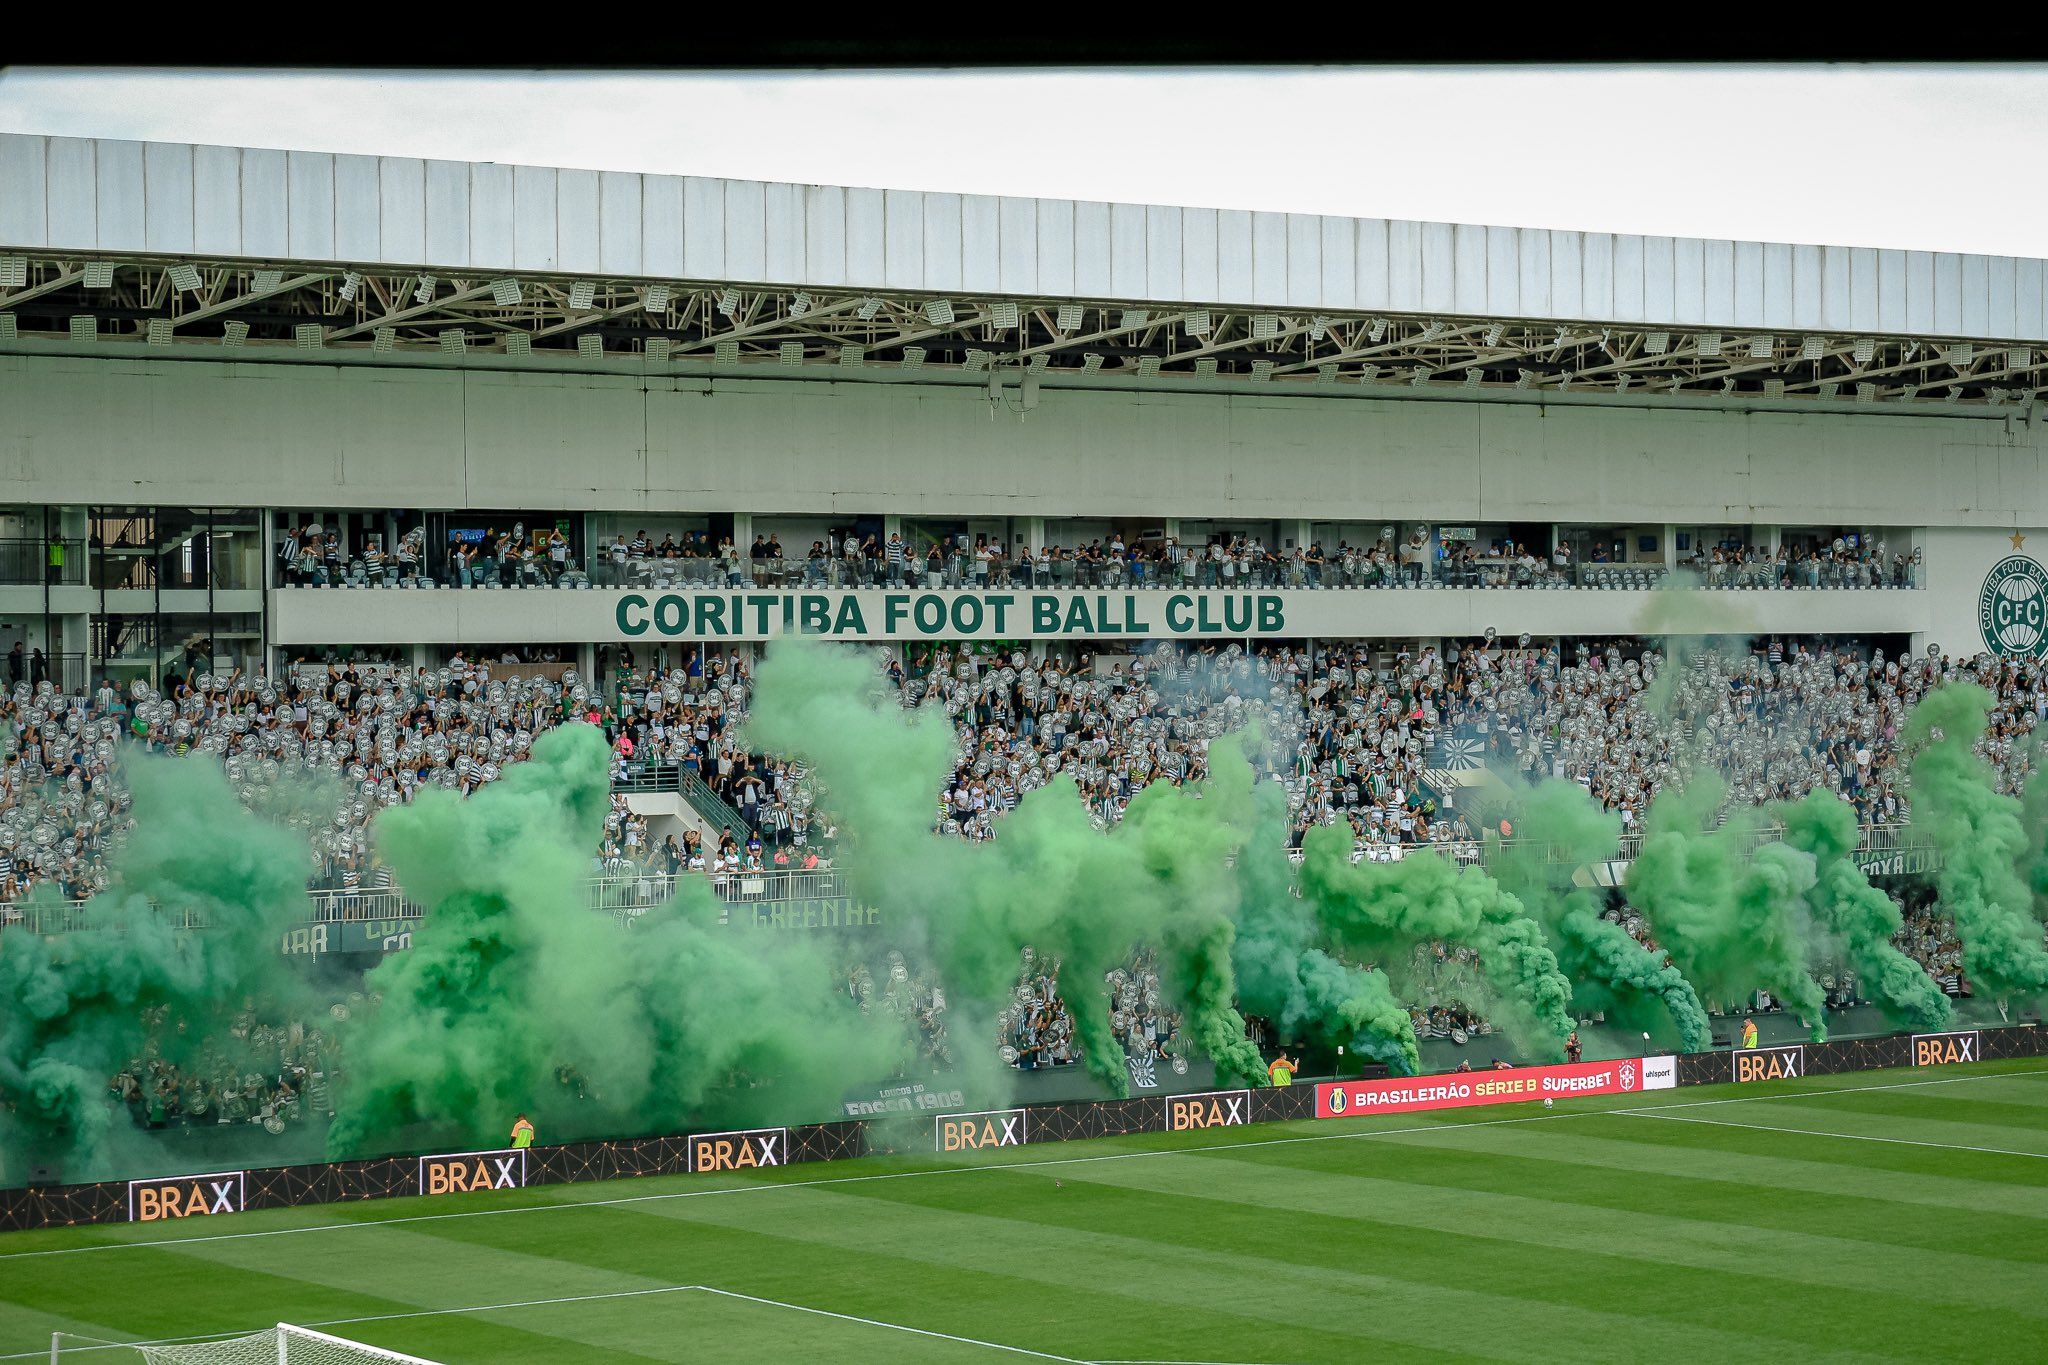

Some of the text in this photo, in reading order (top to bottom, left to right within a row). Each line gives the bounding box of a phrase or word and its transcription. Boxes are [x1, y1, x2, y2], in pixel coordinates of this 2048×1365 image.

[1982, 560, 2048, 630] CORITIBA FOOT BALL
[615, 594, 1286, 635] CORITIBA FOOT BALL CLUB
[1998, 600, 2039, 625] CFC
[752, 899, 839, 928] GREEN
[1739, 1052, 1797, 1082] BRAX
[1918, 1037, 1974, 1066] BRAX
[1355, 1072, 1612, 1106] BRASILEIRÃO SÉRIE B SUPERBET
[1645, 1070, 1670, 1078] uhlsport
[879, 1084, 925, 1098] LOUCOS DO
[1174, 1097, 1243, 1130] BRAX
[945, 1116, 1018, 1150] BRAX
[697, 1136, 778, 1172] BRAX
[430, 1156, 517, 1194] BRAX
[140, 1179, 235, 1220] BRAX
